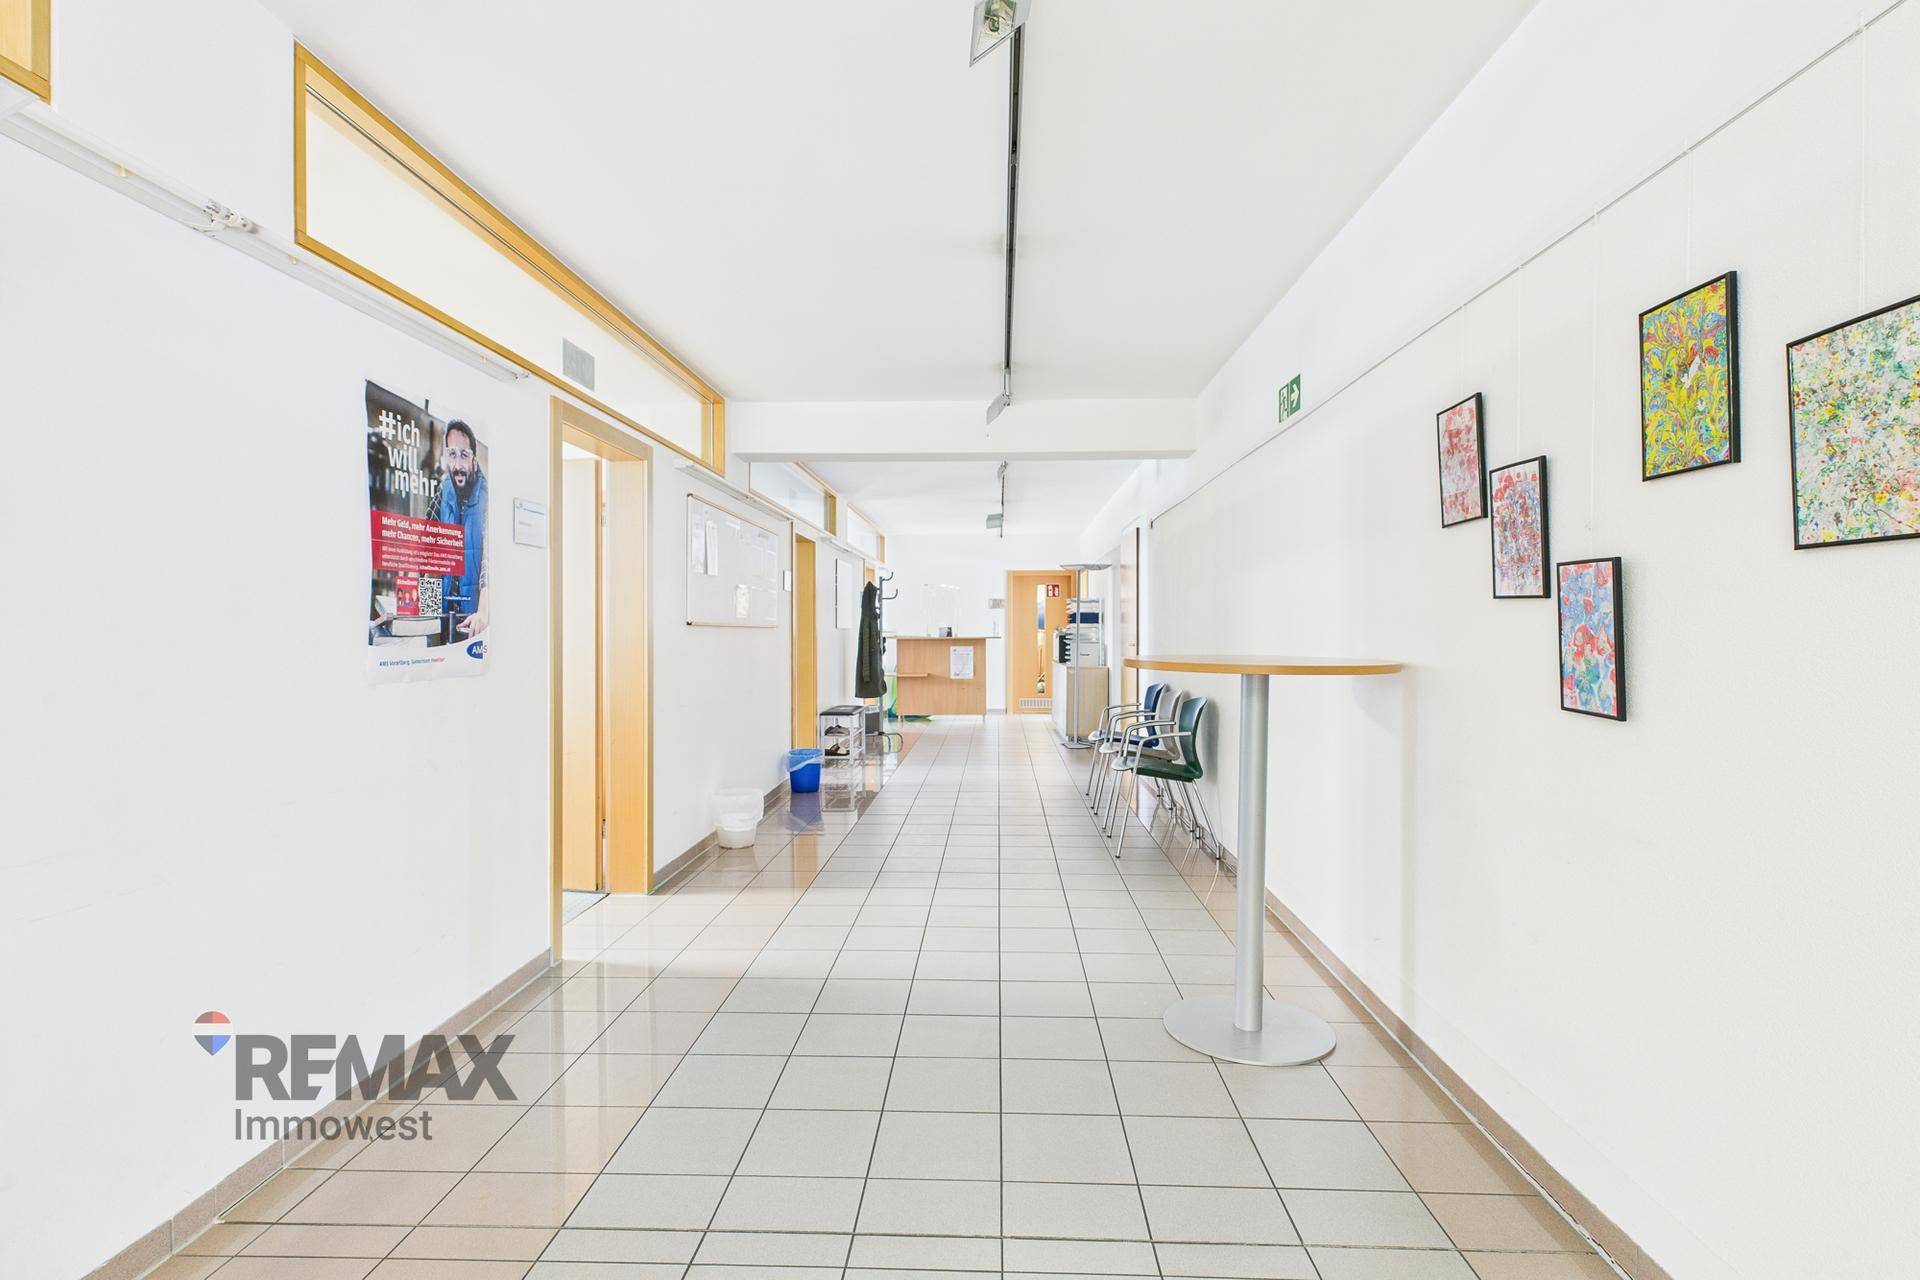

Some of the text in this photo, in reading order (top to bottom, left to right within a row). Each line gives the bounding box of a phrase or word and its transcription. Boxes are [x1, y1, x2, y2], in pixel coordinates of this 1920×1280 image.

[379, 409, 420, 448] #ich
[387, 444, 419, 474] will
[394, 470, 438, 498] mehr
[382, 516, 397, 526] Mehr
[397, 519, 411, 531] Geld,
[411, 523, 426, 532] mehr
[382, 530, 397, 538] mehr
[421, 535, 436, 544] mehr
[471, 645, 488, 655] AMS
